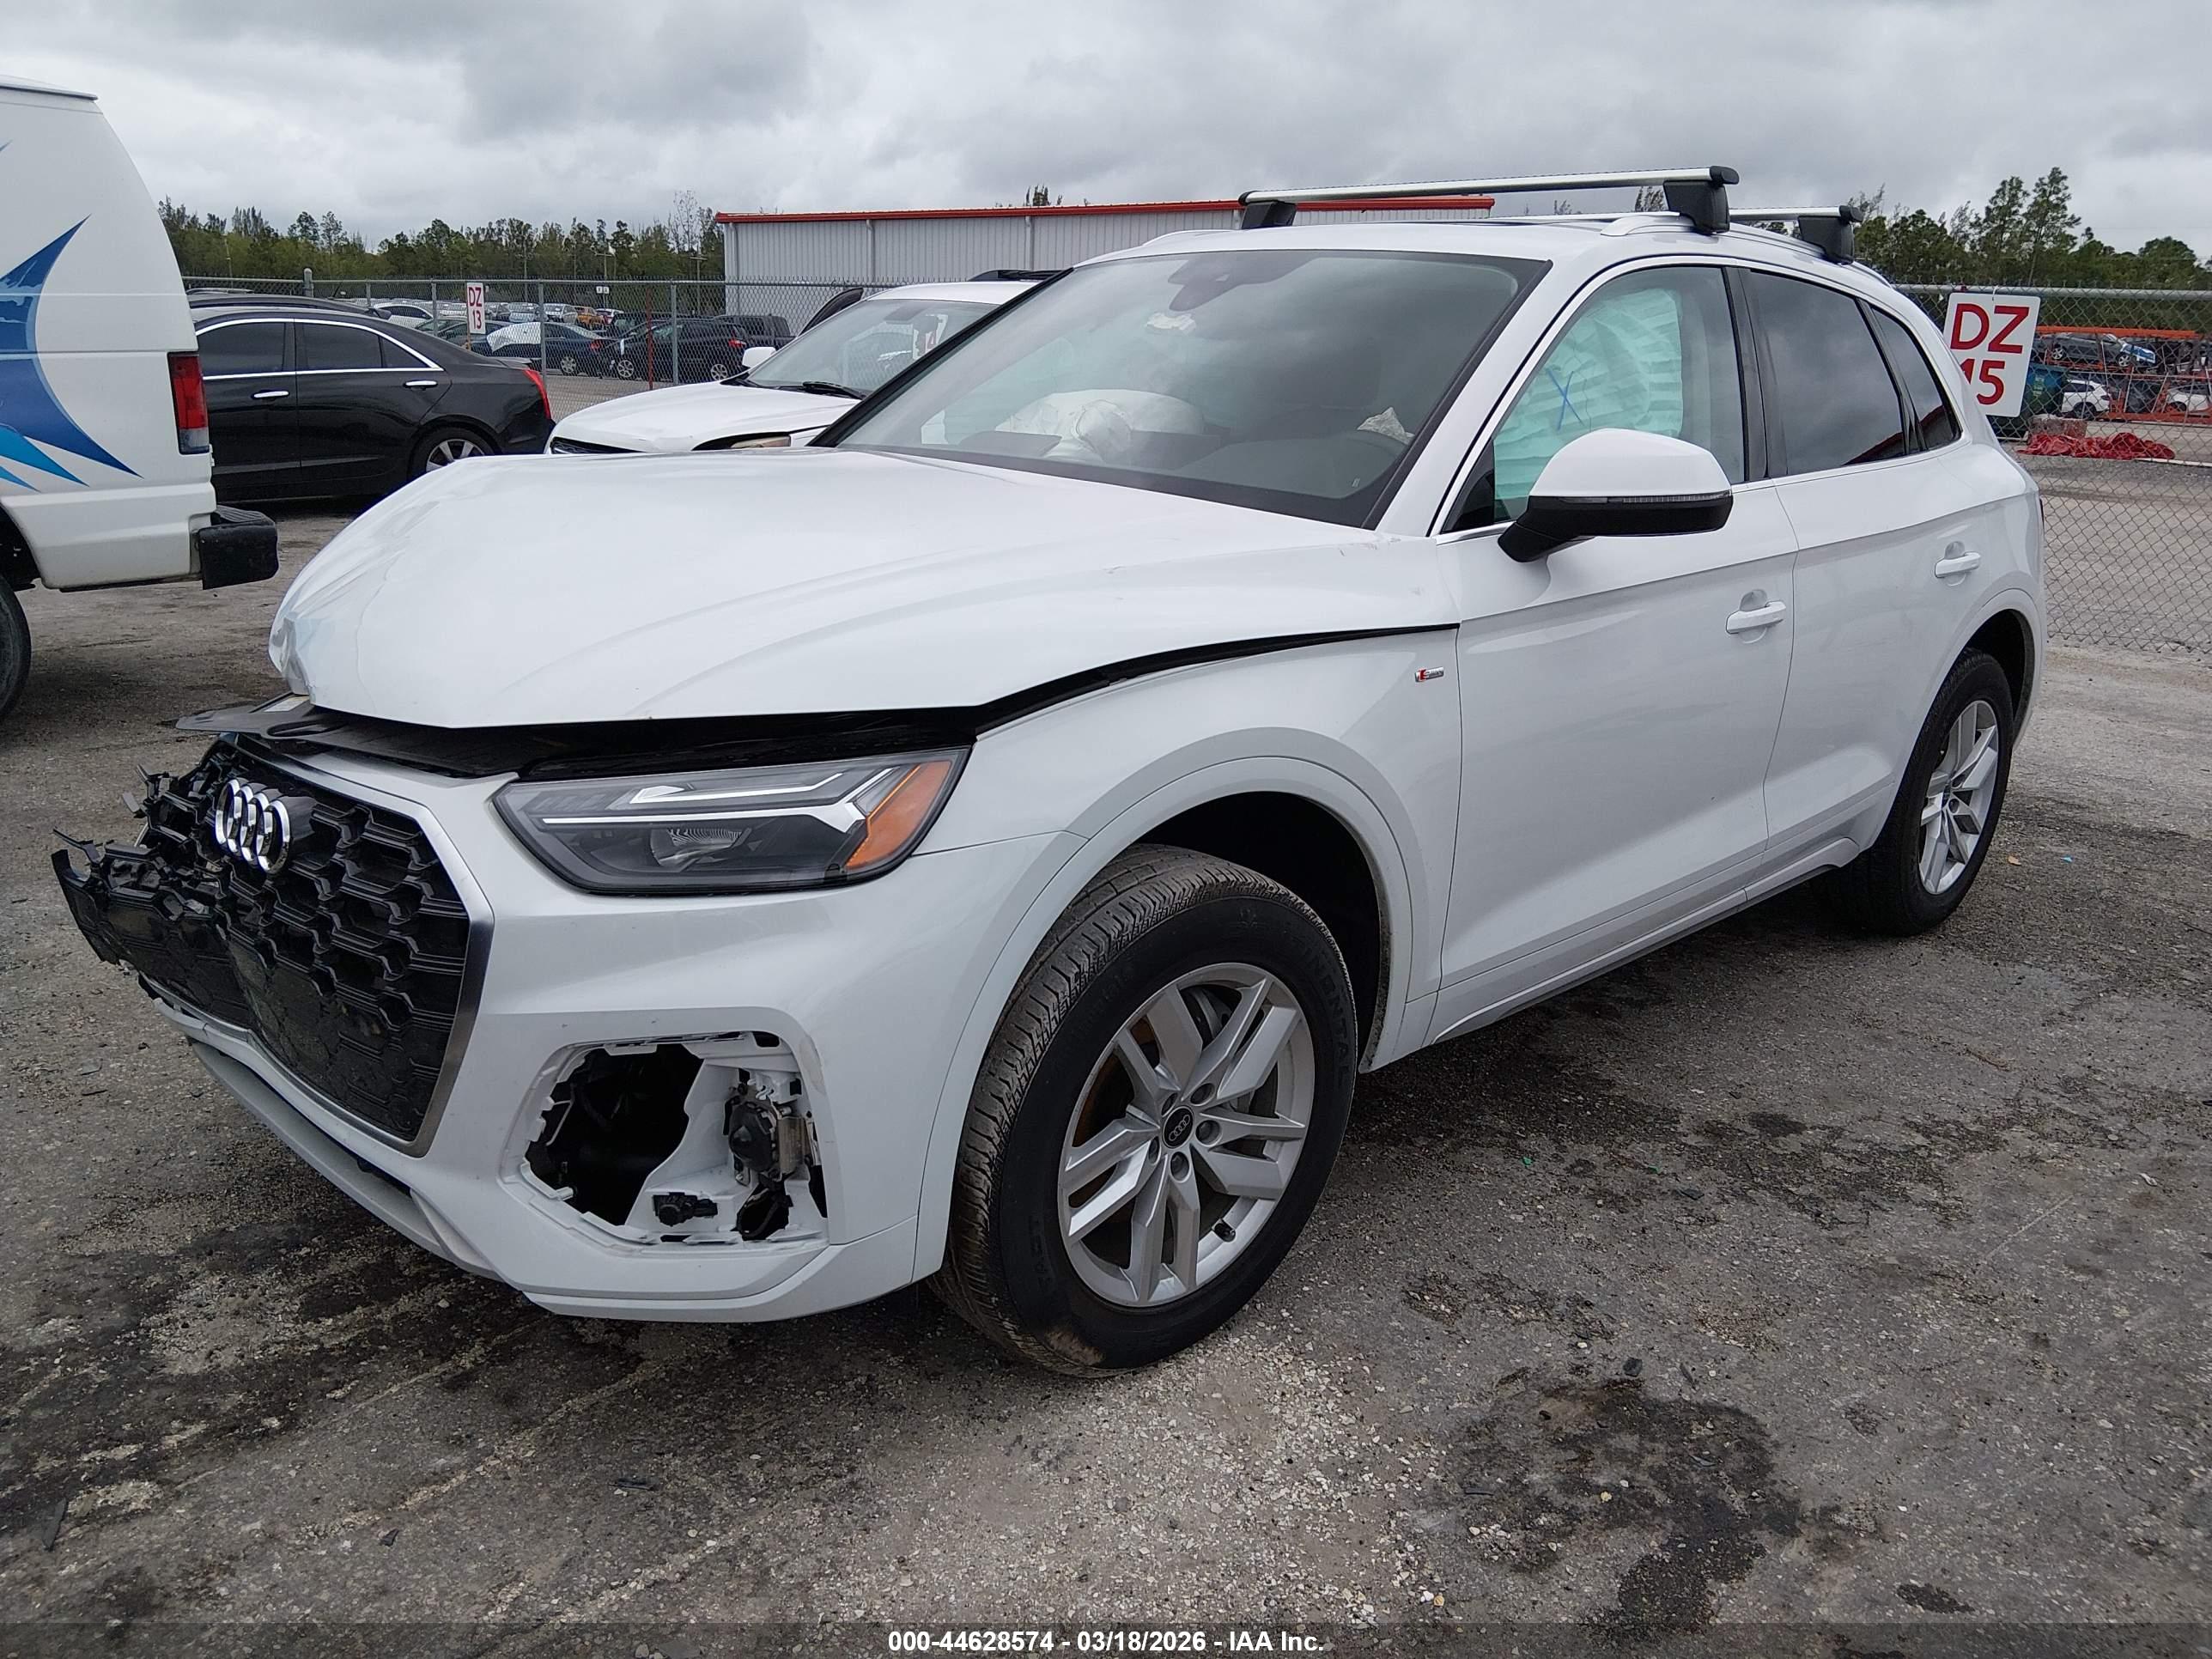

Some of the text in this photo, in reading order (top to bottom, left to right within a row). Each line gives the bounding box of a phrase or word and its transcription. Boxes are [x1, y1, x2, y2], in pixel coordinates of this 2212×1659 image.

[468, 287, 483, 307] DZ
[472, 310, 483, 330] 13
[1950, 303, 2030, 354] DZ
